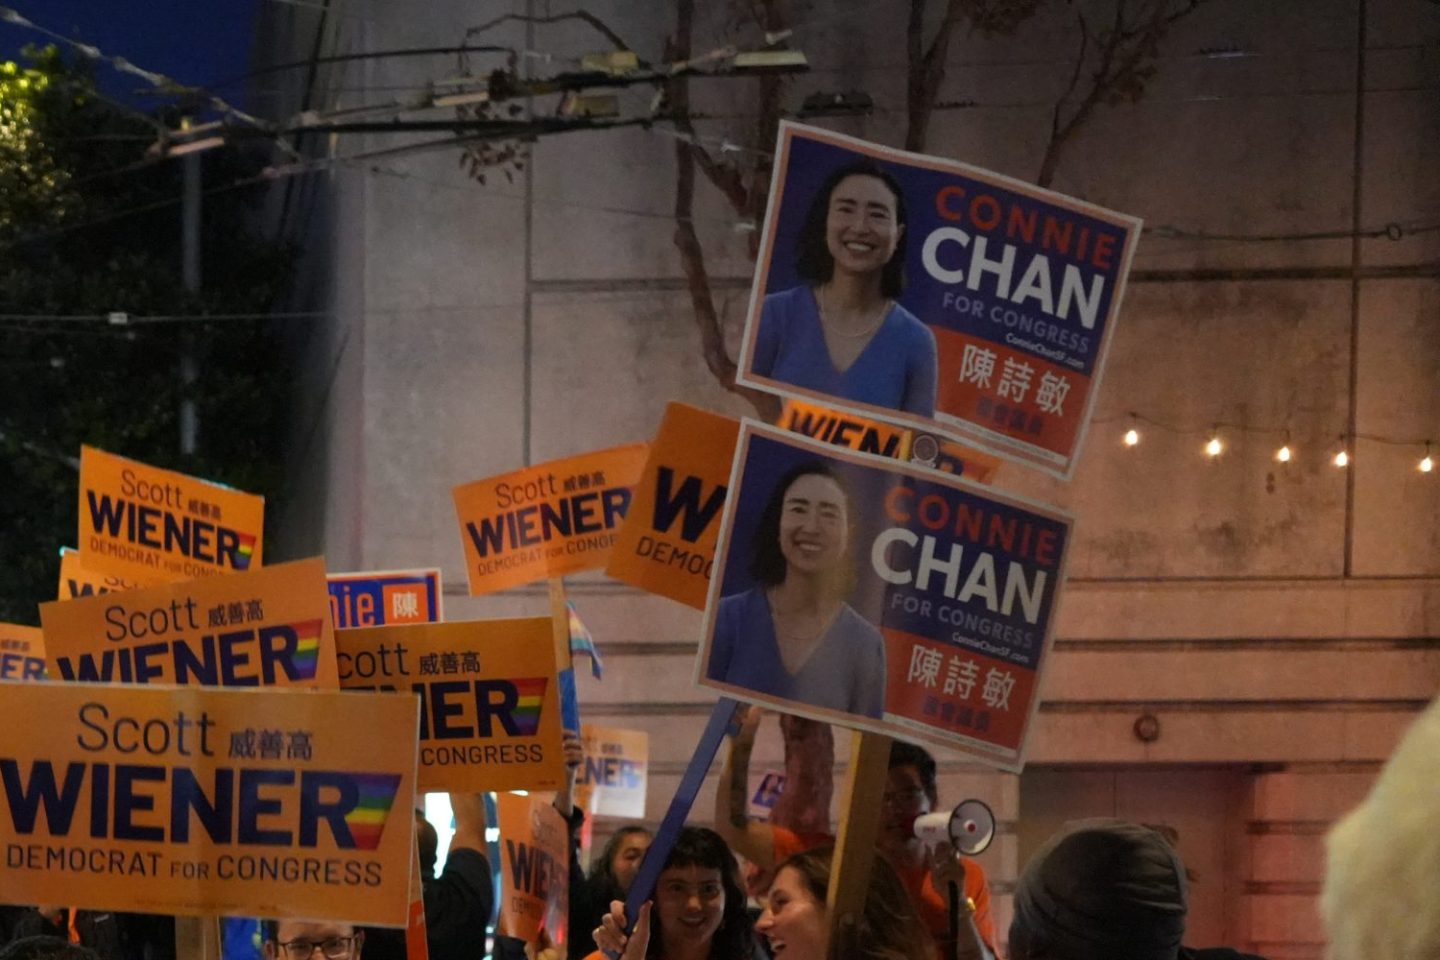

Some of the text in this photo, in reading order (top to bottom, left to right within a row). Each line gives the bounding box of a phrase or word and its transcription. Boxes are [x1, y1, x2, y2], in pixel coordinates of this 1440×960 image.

[936, 186, 1116, 270] CONNIE
[922, 226, 1106, 330] CHAN
[943, 291, 1091, 354] FOR CONGRESS
[959, 343, 1071, 417] 陳詩敏
[790, 410, 902, 460] WIEN
[120, 468, 184, 510] Scott
[495, 472, 557, 509] Scott
[87, 489, 252, 572] WIENER
[90, 537, 161, 569] DEMOCRAT
[466, 487, 634, 559] WIENER
[884, 485, 1058, 566] CONNIE
[477, 548, 545, 577] DEMOCRAT
[871, 527, 1047, 625] CHAN
[105, 597, 200, 642] Scott
[891, 592, 1036, 650] FOR CONGRESS
[57, 623, 304, 686] WIENER
[338, 643, 410, 680] cott
[908, 643, 1016, 711] 陳詩敏
[77, 703, 313, 761] Scott 威善高
[421, 745, 543, 766] CONGRESS
[0, 758, 364, 851] WIENER
[7, 844, 382, 888] DEMOCRAT FOR CONGRESS
